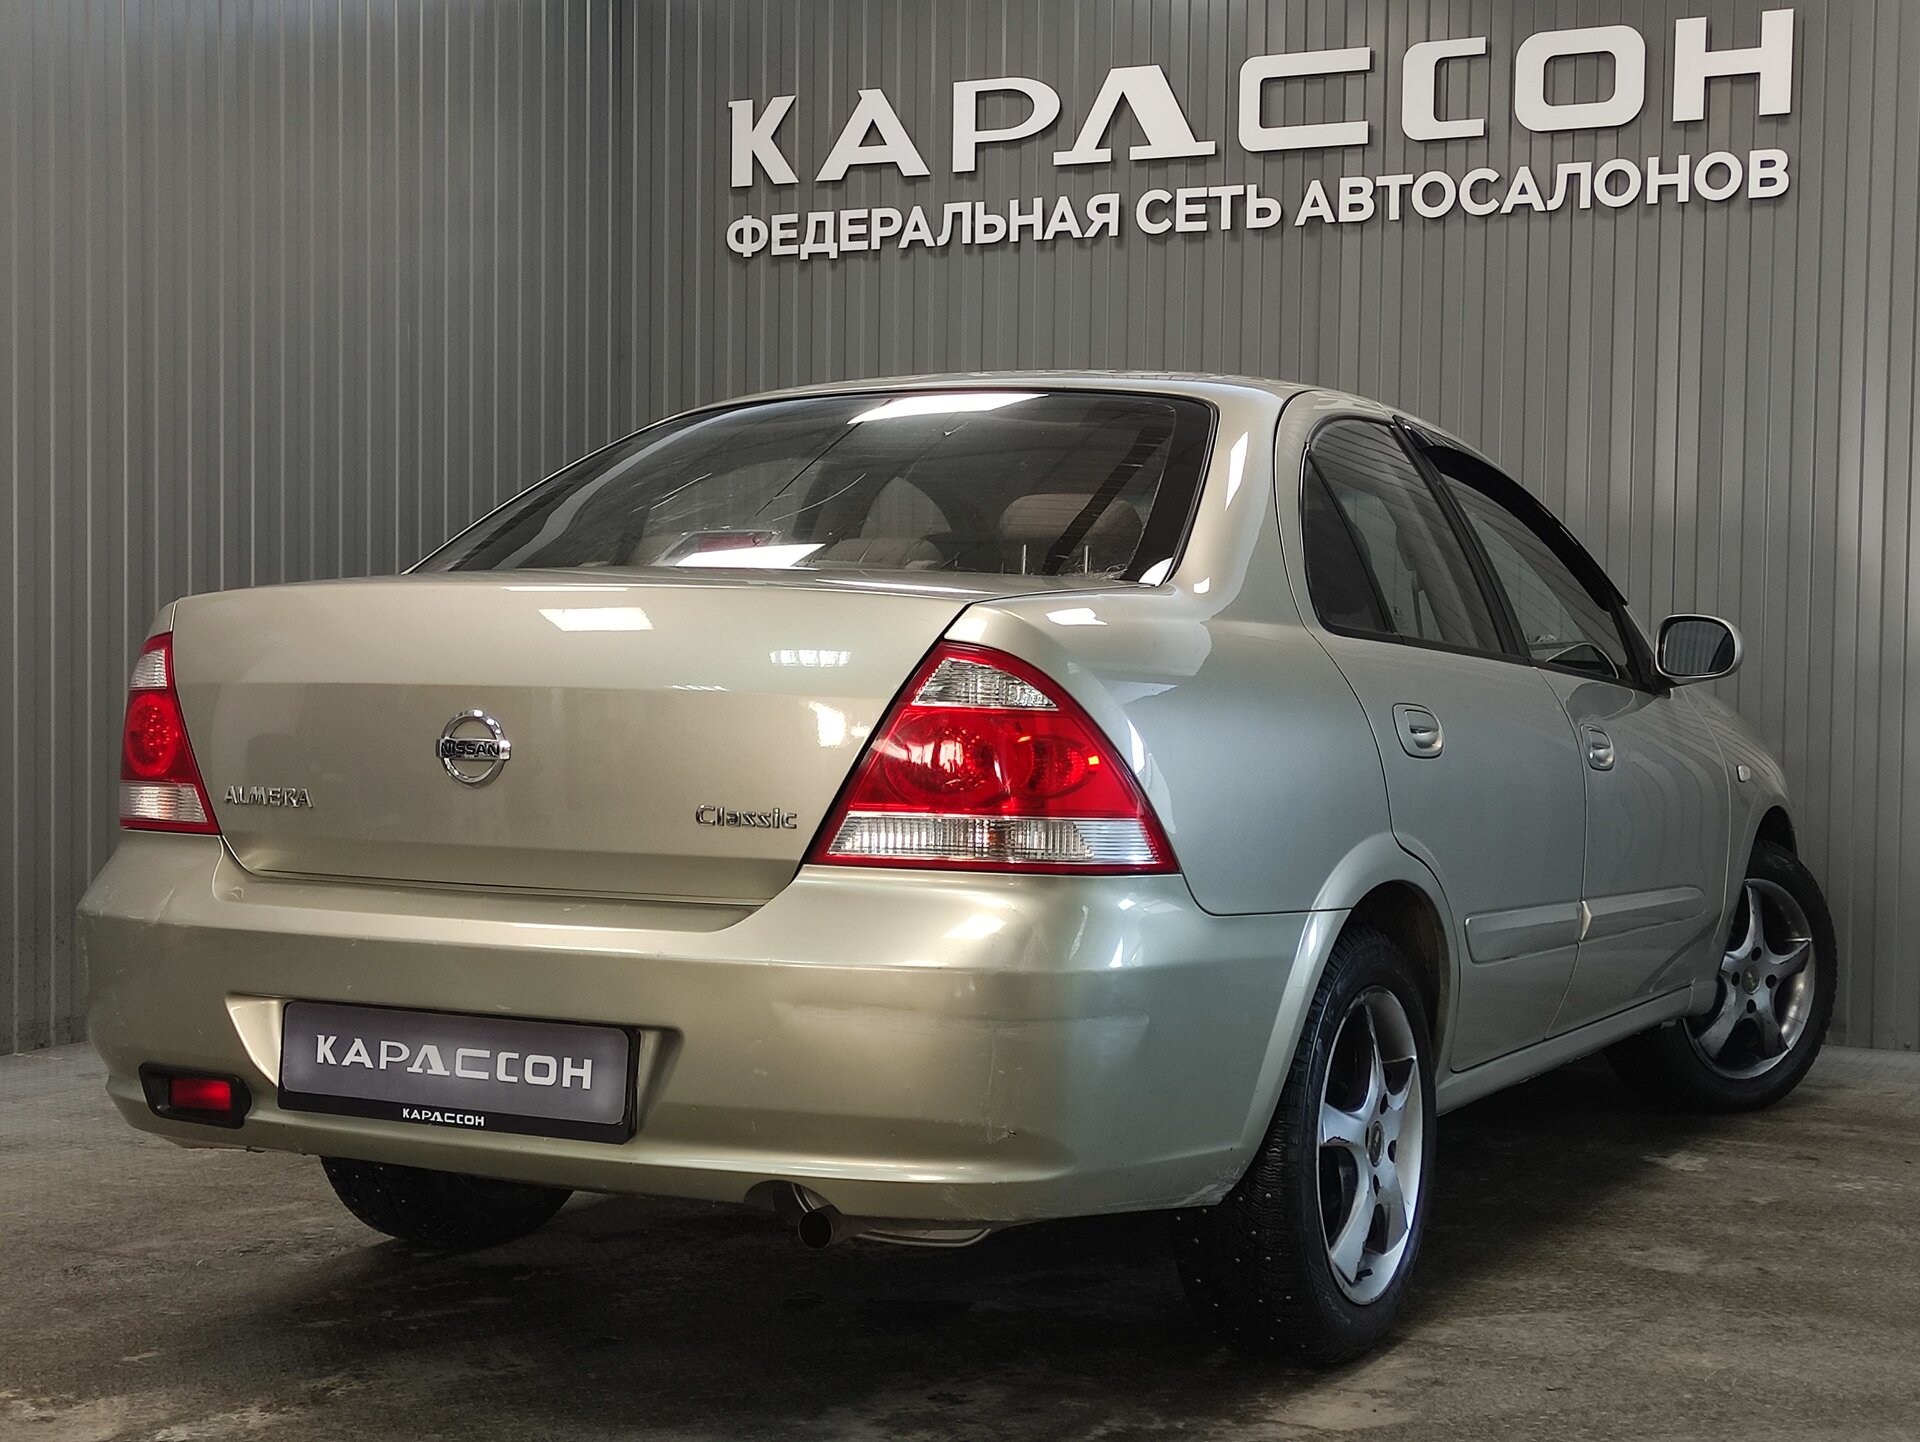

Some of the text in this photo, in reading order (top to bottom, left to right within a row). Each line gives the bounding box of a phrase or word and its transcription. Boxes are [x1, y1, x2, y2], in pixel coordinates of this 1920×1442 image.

[726, 149, 1790, 260] ФЕДЕРАЛЬНАЯ СЕТЬ АВТОСАЛОНОВ
[440, 741, 500, 757] NISSAN
[223, 785, 313, 808] ALMERA
[695, 804, 798, 829] Classic
